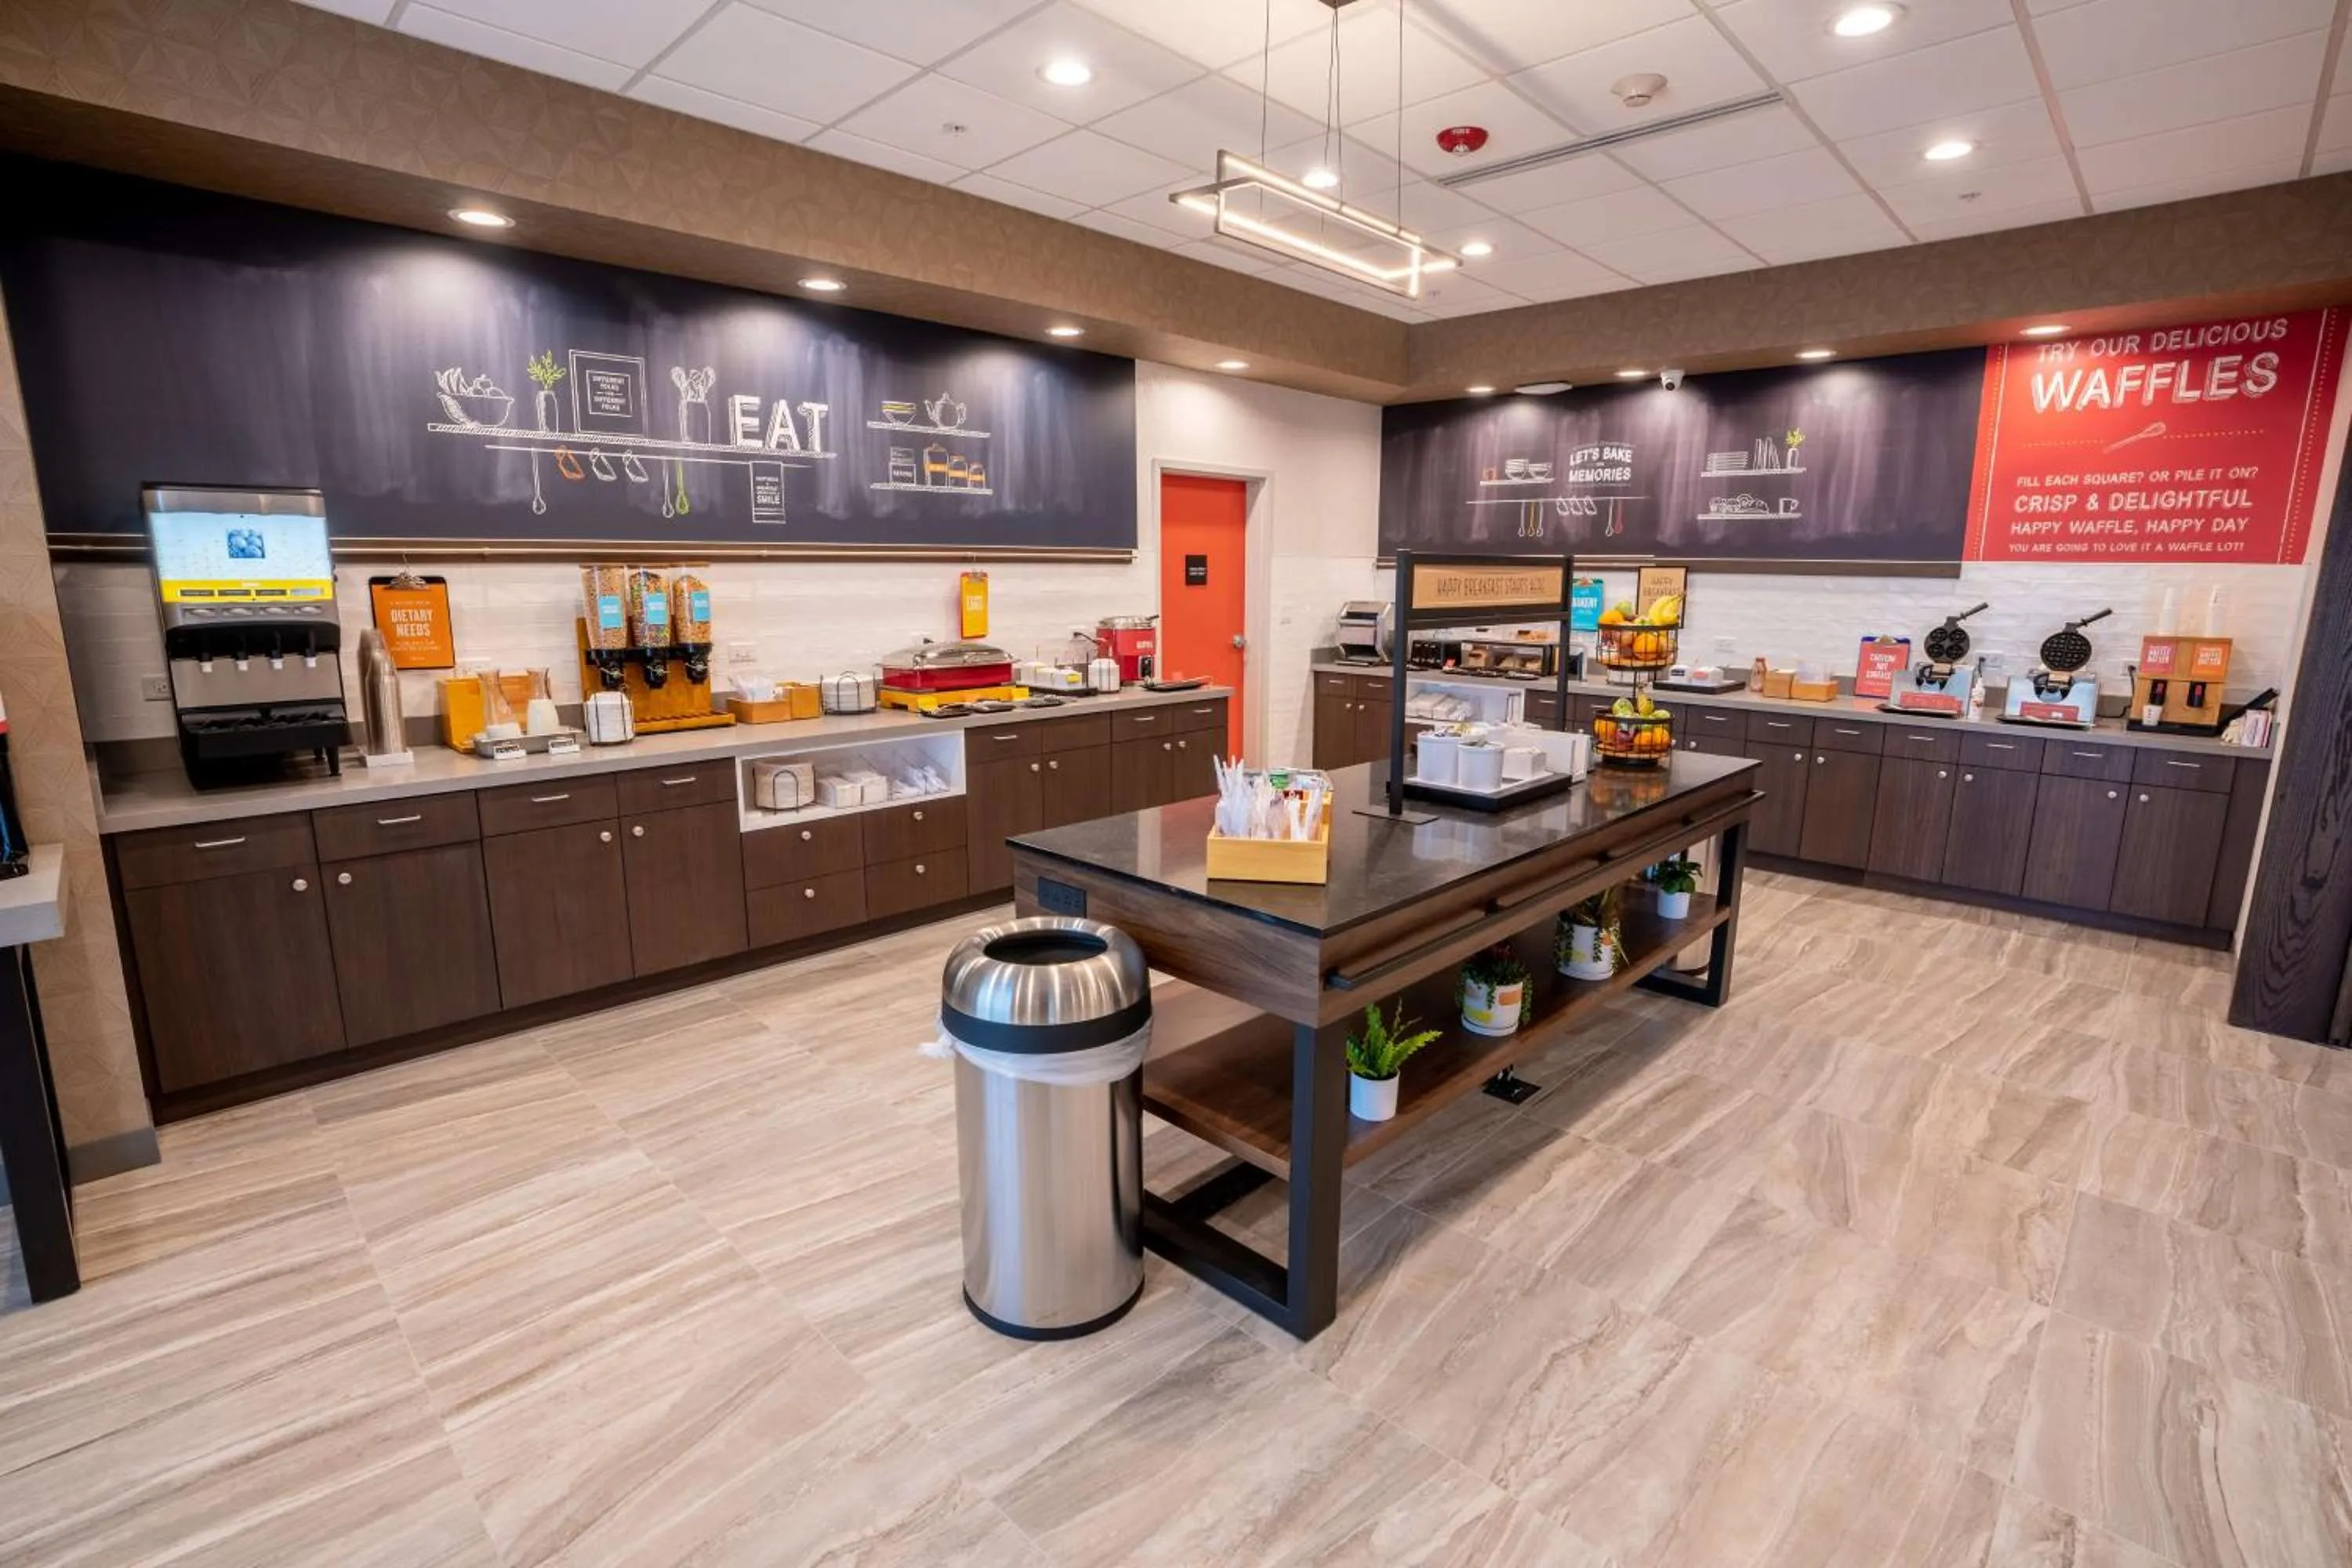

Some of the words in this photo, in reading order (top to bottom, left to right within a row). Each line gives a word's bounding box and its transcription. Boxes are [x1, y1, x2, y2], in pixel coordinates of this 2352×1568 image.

[2038, 340, 2081, 364] TRY
[2089, 335, 2141, 358] OUR
[2150, 318, 2289, 354] DELICIOUS
[2031, 351, 2280, 414] WAFFLES
[728, 394, 828, 452] EAT
[1570, 448, 1600, 466] LET'S
[1602, 446, 1632, 463] BAKE
[1569, 467, 1632, 482] MEMORIES
[2017, 476, 2041, 487] FILL
[2045, 474, 2079, 487] EACH
[2082, 471, 2144, 485] SQUARE?
[2149, 470, 2170, 483] OR
[2174, 470, 2205, 481] PILE
[2209, 468, 2223, 480] IT
[2228, 466, 2259, 479] ON?
[2014, 493, 2078, 514] CRISP
[2085, 492, 2100, 512] &
[2109, 488, 2253, 511] DELIGHTFUL
[2010, 521, 2063, 535] HAPPY
[2069, 519, 2139, 535] WAFFLE,
[2146, 518, 2205, 533] HAPPY
[2211, 517, 2250, 532] DAY
[2009, 543, 2027, 553] YOU
[2031, 543, 2053, 553] ARE
[2056, 543, 2089, 552] GOING
[2092, 543, 2107, 552] TO
[2110, 542, 2138, 552] LOVE
[2140, 542, 2152, 552] IT
[2154, 542, 2164, 552] A
[2168, 542, 2213, 552] WAFFLE
[390, 608, 433, 622] DIETARY
[396, 623, 431, 637] NEEDS
